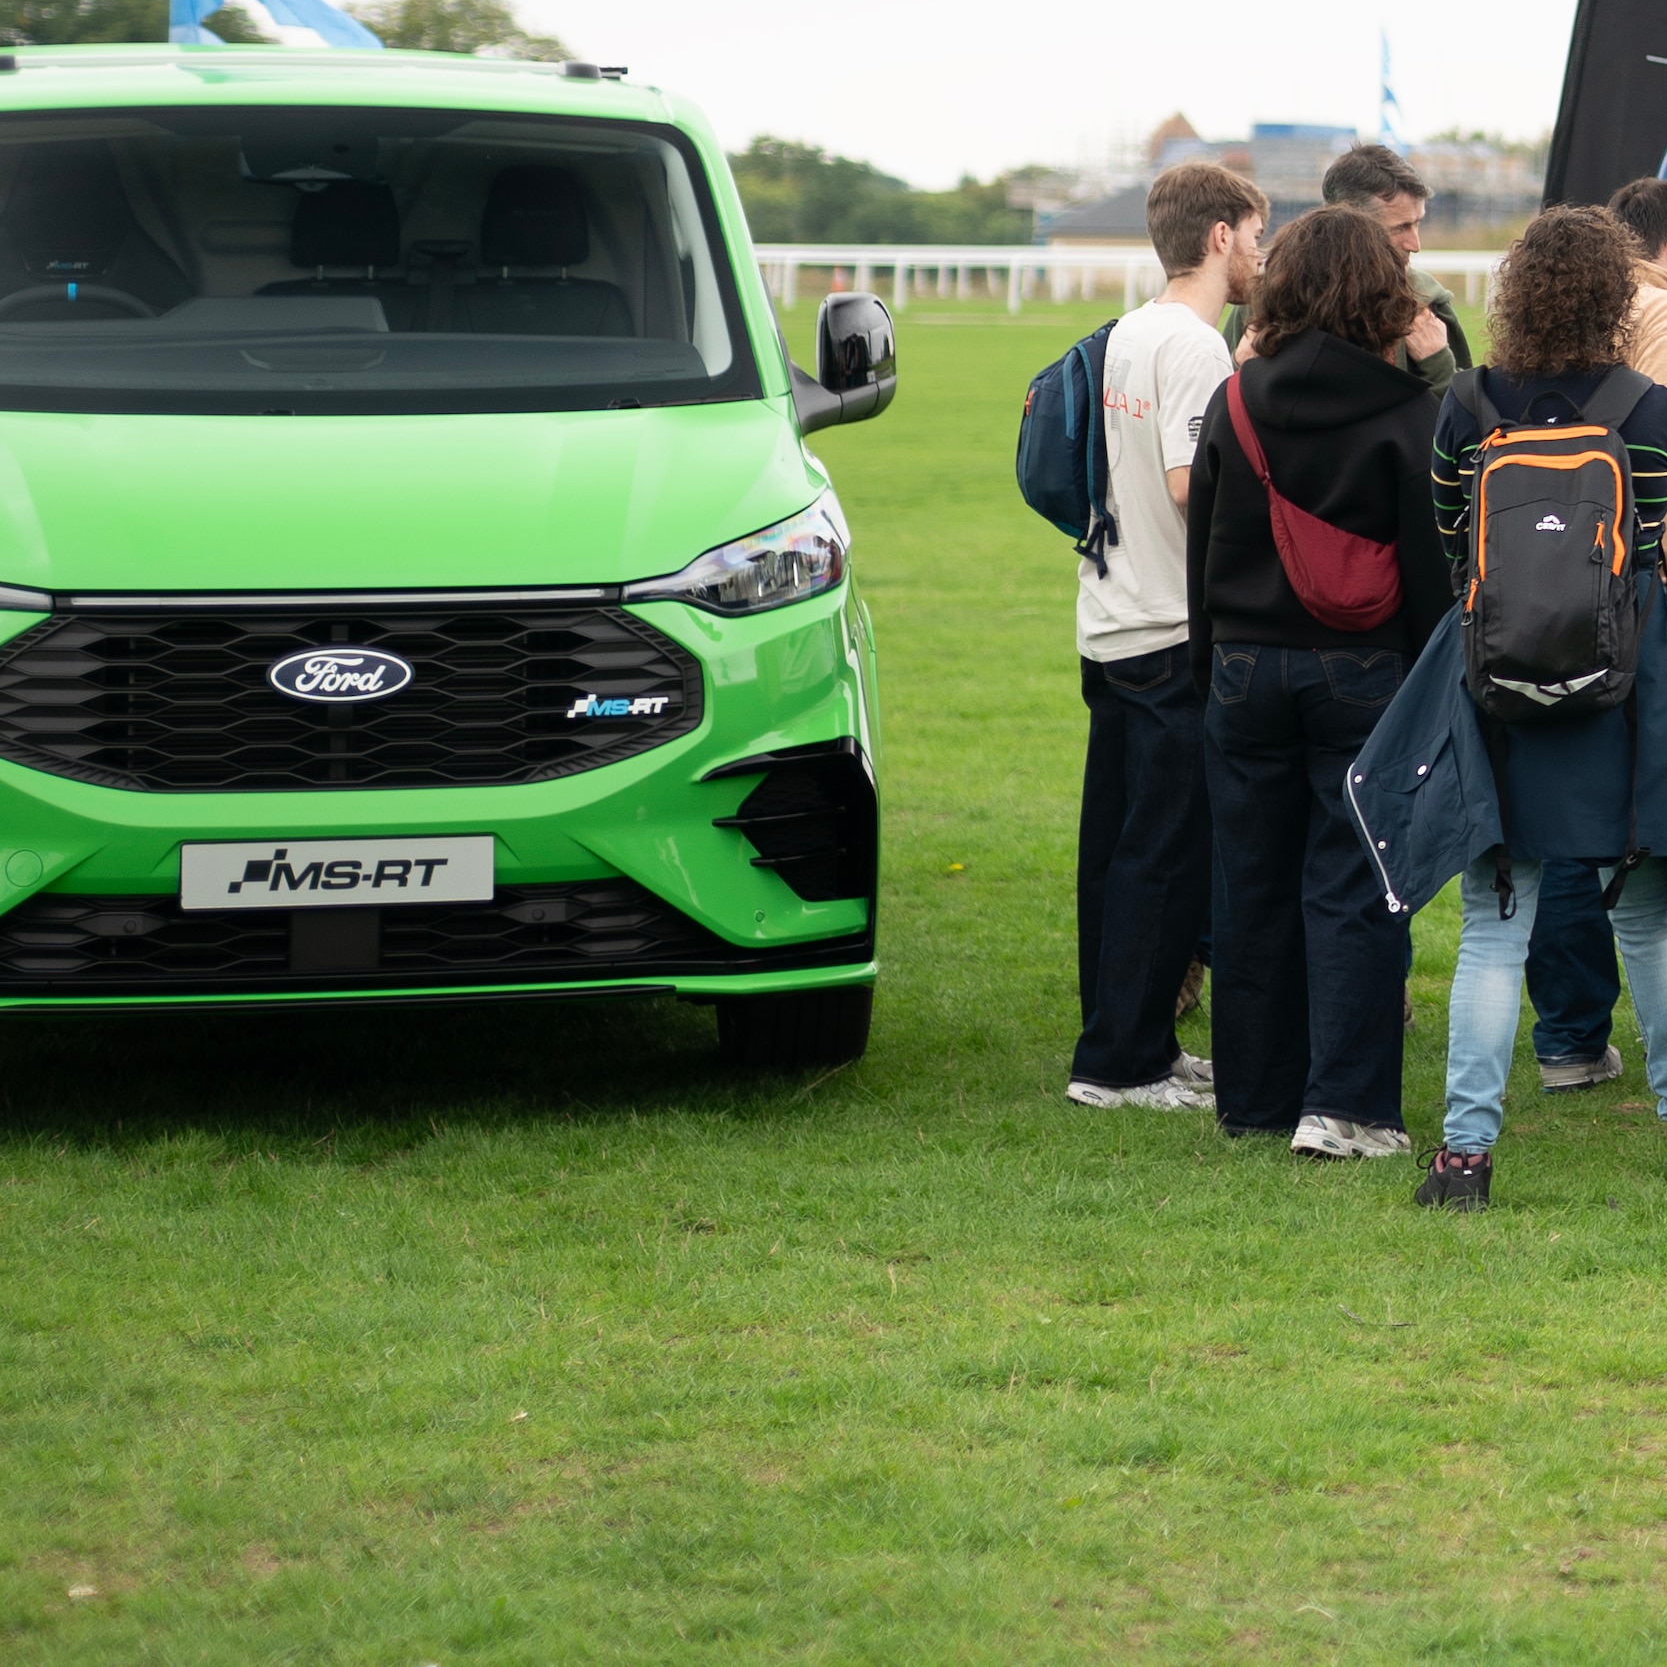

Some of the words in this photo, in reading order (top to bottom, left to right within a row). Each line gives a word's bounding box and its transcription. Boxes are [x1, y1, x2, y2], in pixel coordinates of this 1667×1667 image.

[295, 655, 385, 693] Ford
[586, 696, 669, 718] MS-RT
[269, 858, 449, 891] MS-RT
